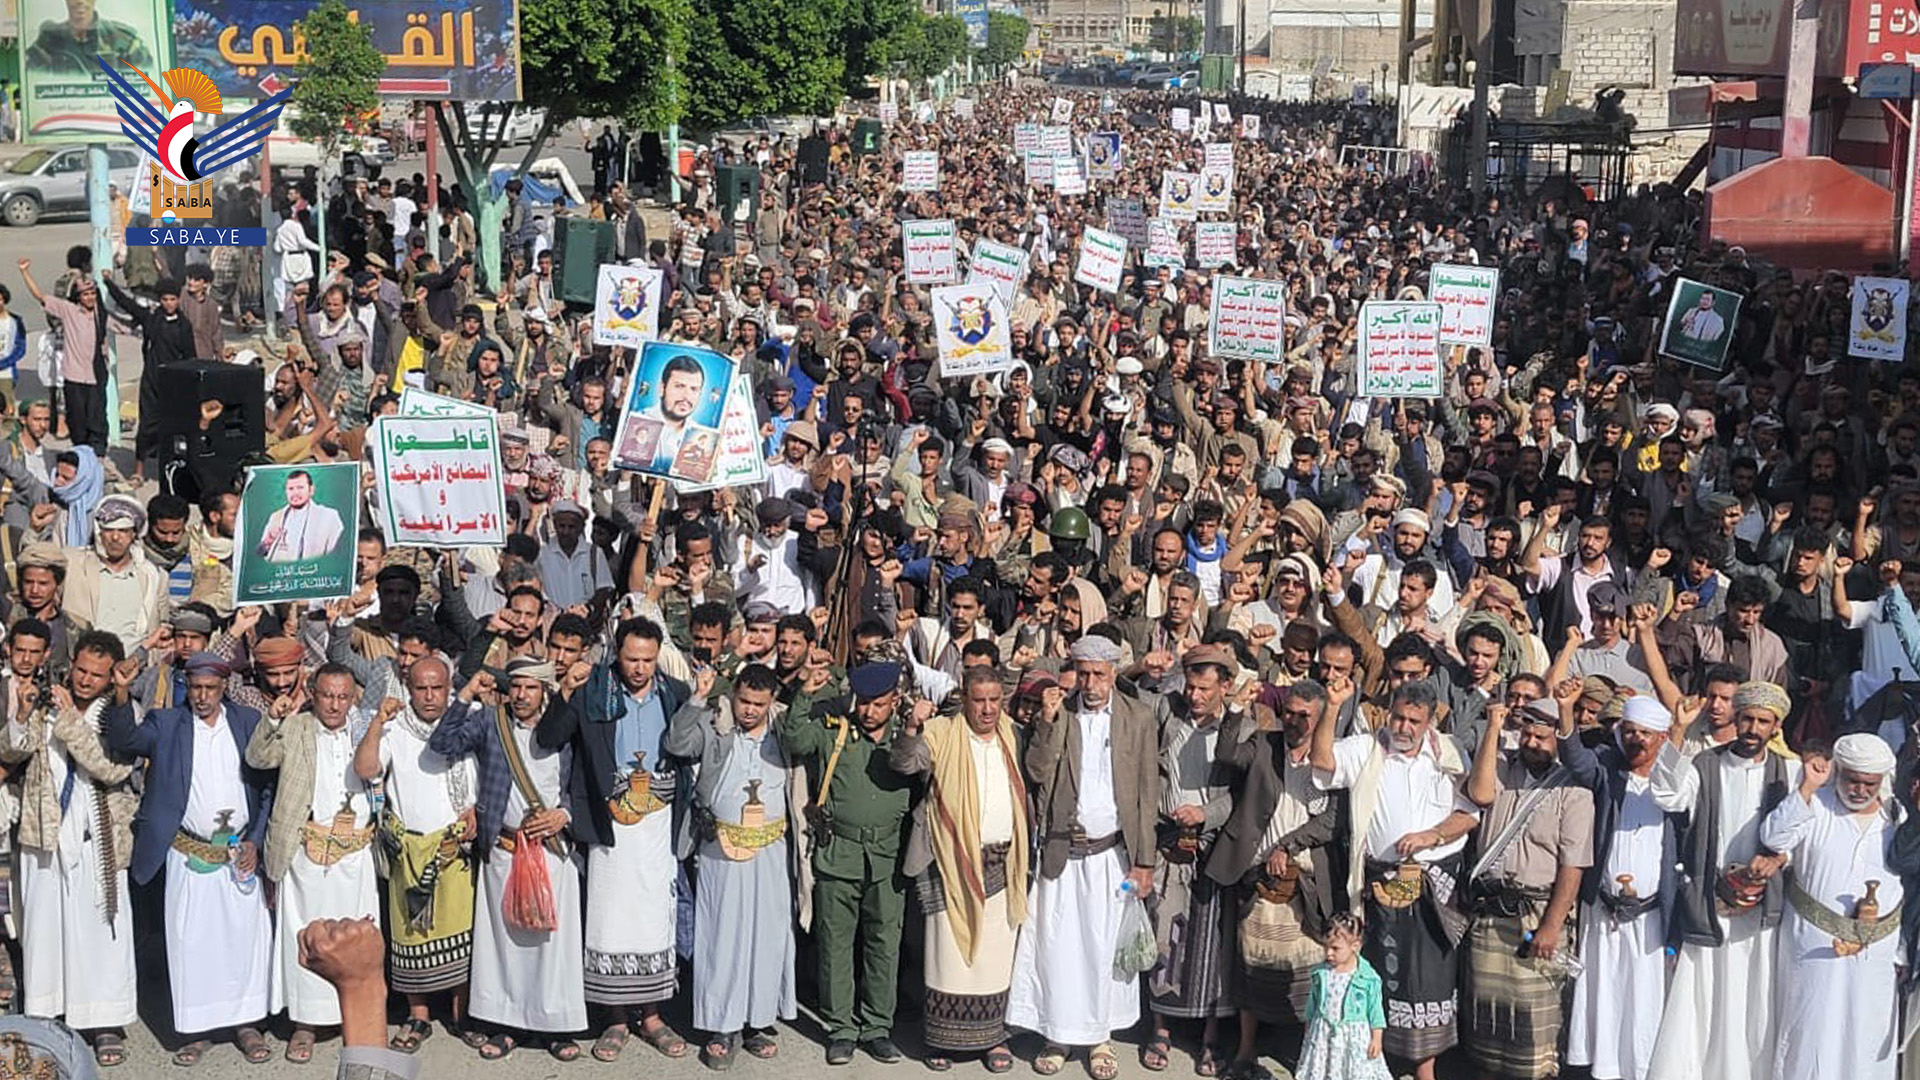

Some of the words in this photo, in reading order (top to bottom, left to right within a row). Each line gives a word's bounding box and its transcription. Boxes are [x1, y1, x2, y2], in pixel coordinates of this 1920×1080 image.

[1370, 306, 1411, 329] أكبر
[1412, 309, 1439, 324] الله
[388, 427, 490, 457] قاطعوا
[446, 461, 492, 484] البضائع
[439, 488, 447, 506] و
